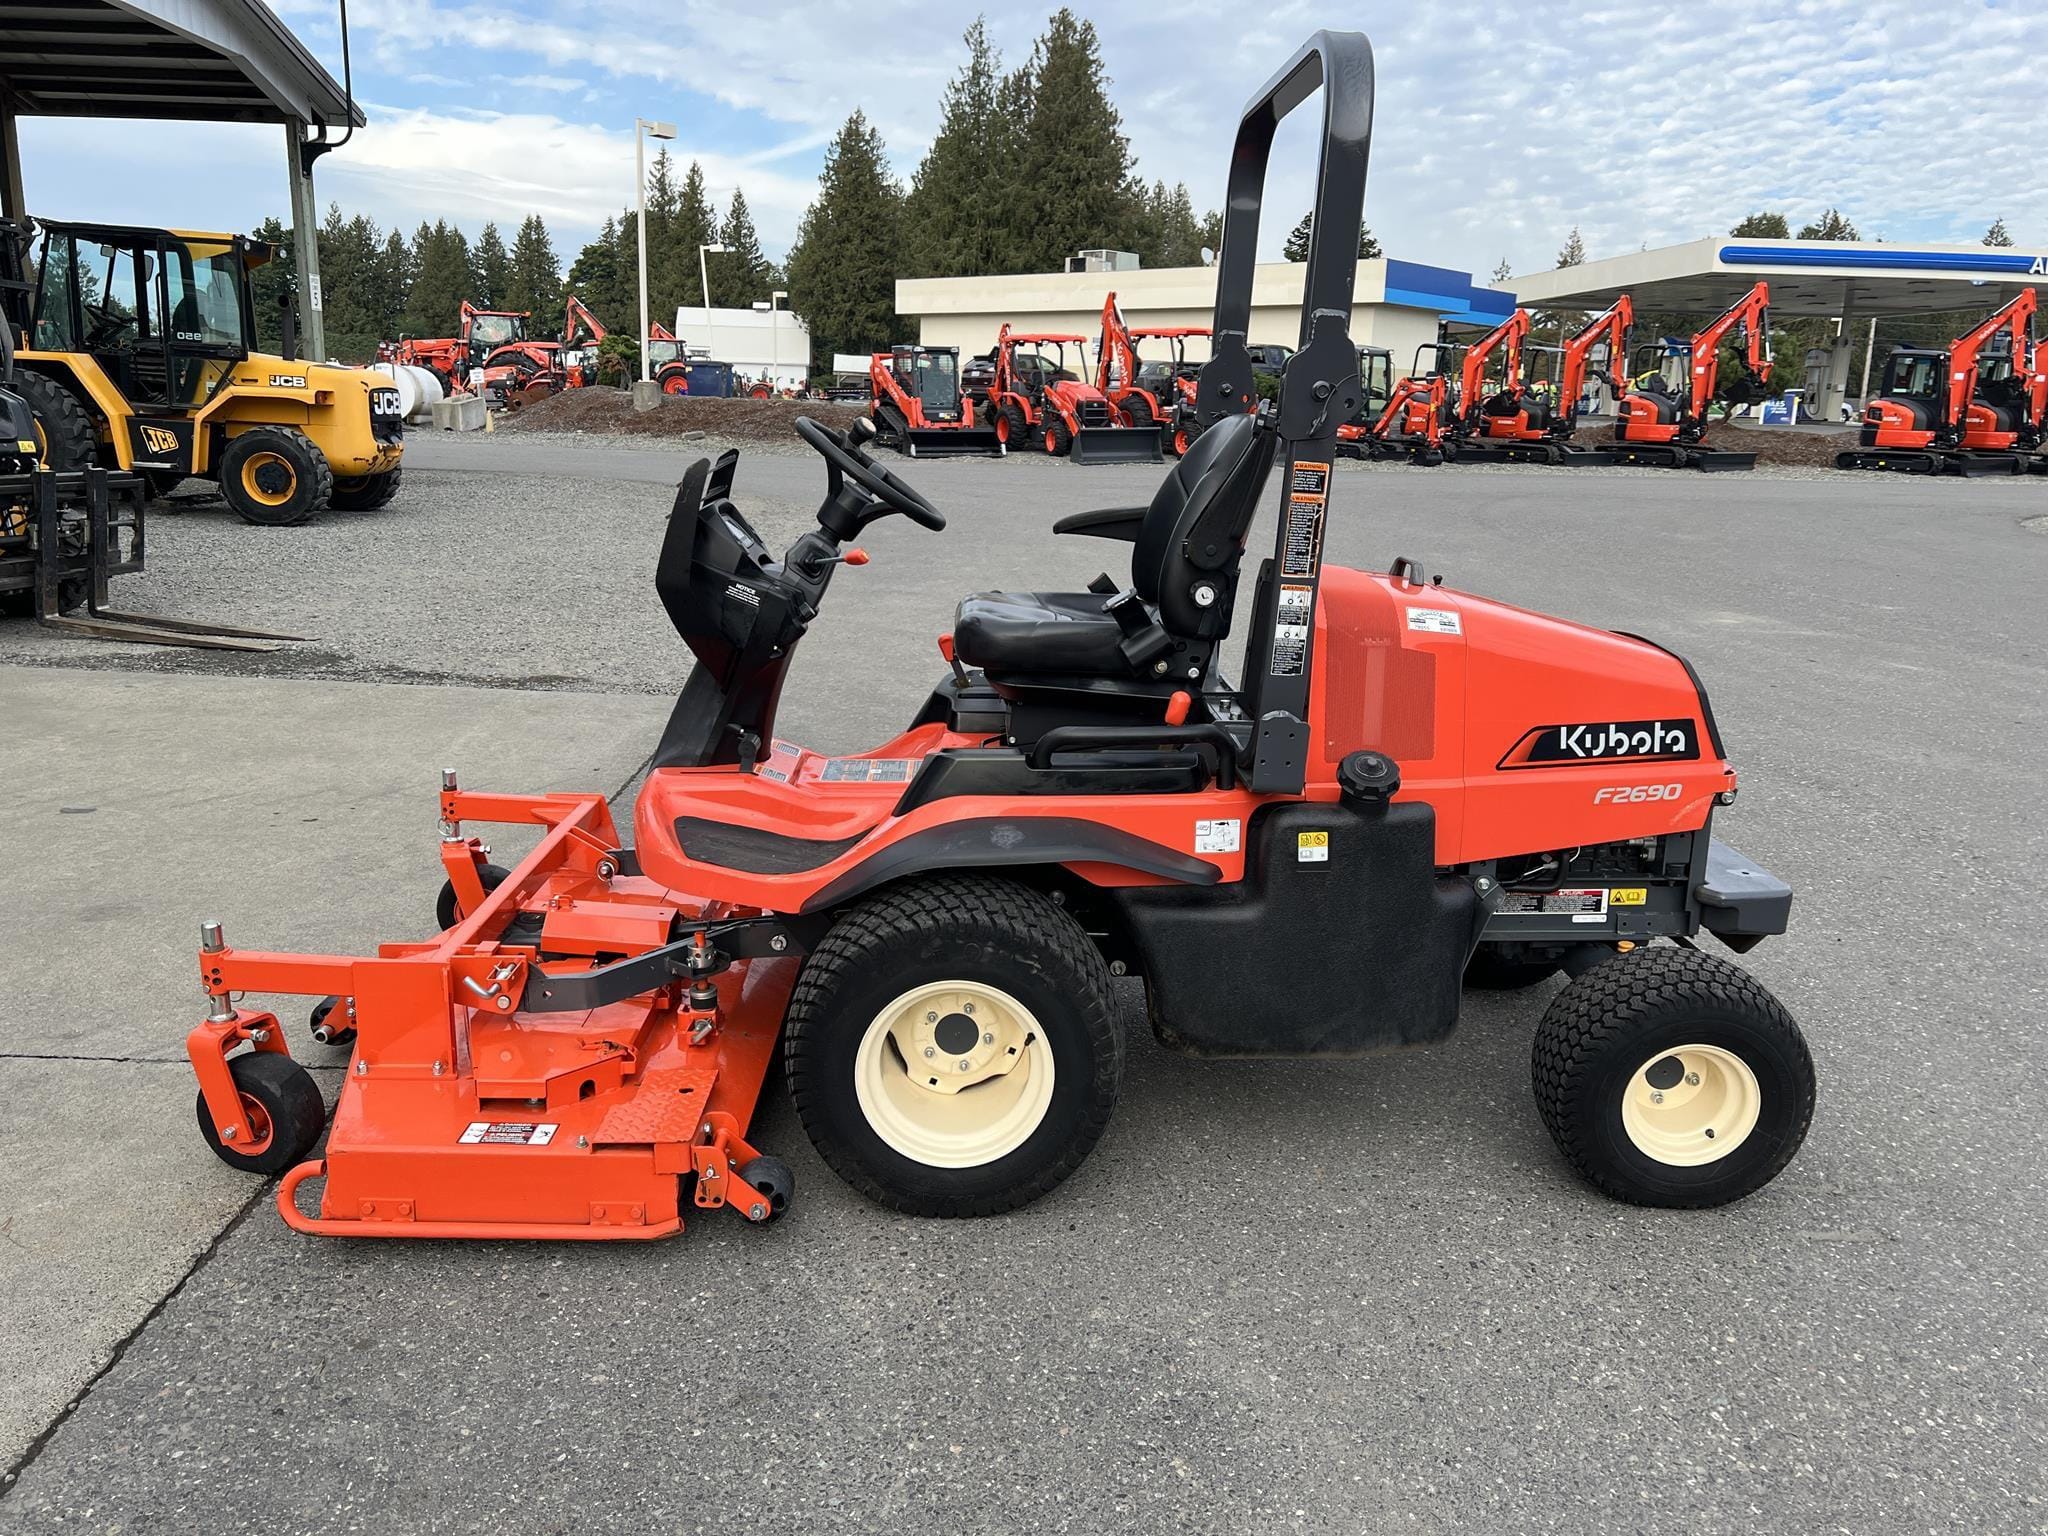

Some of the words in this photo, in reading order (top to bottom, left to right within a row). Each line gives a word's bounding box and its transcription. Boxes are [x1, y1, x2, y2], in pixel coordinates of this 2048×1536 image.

[2029, 257, 2048, 274] A
[270, 375, 305, 388] JCB
[374, 392, 401, 415] JCB
[147, 429, 176, 452] JCB
[735, 583, 757, 595] NOTICE
[1560, 722, 1686, 757] Kubota
[1593, 783, 1683, 805] F2690
